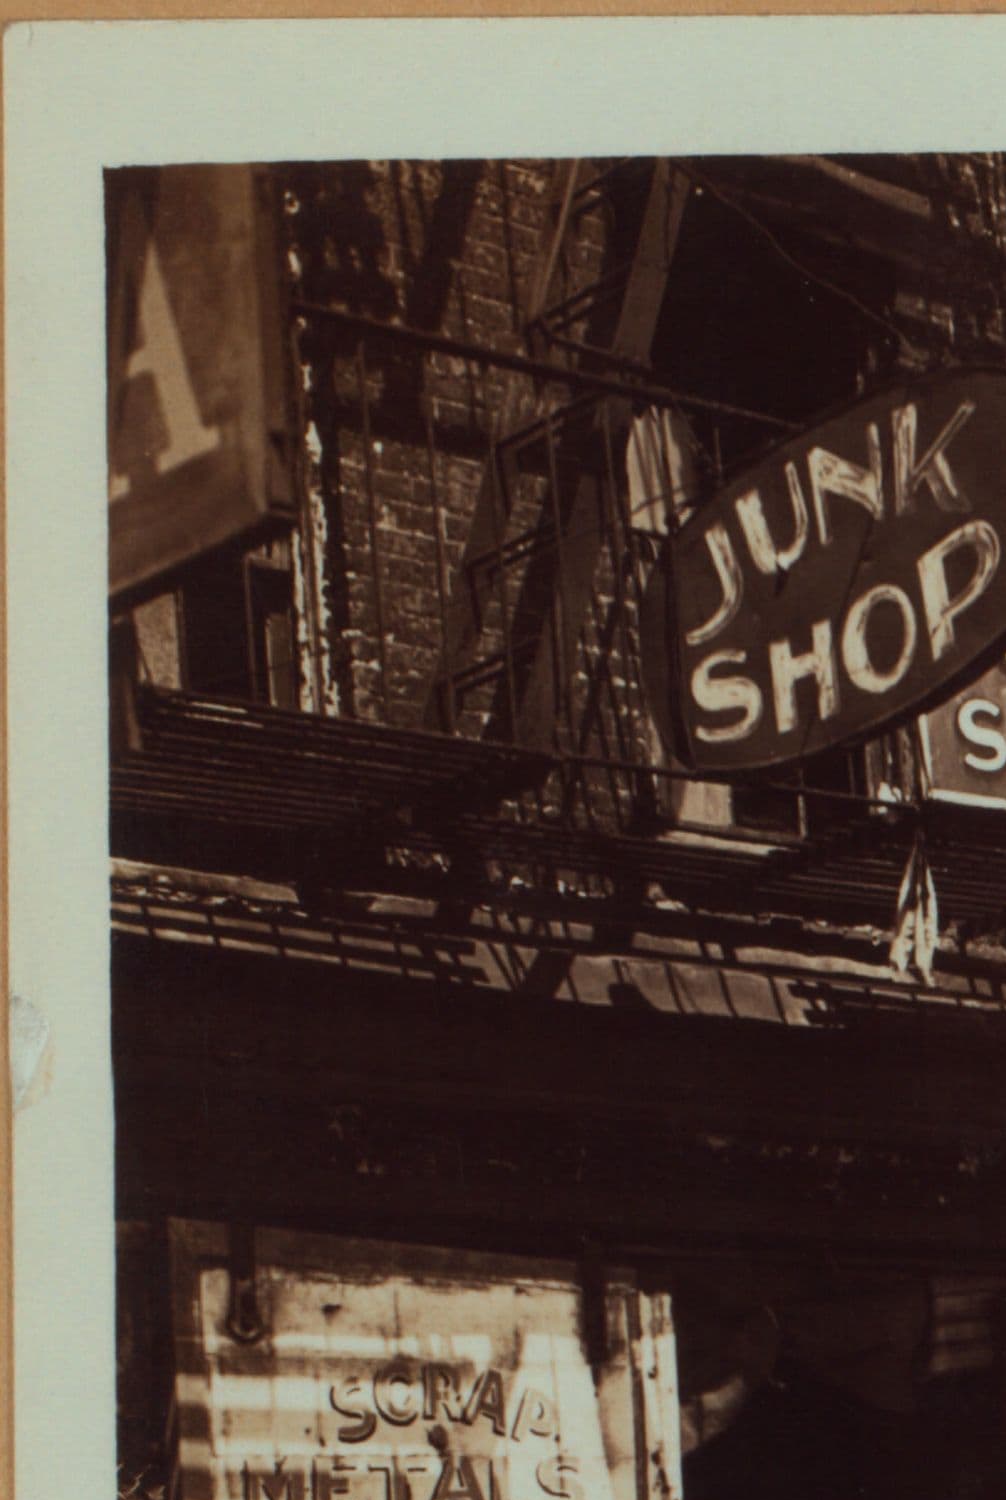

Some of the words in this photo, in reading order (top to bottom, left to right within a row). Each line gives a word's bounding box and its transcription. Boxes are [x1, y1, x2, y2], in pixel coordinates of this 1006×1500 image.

[686, 400, 974, 645] JUNK
[690, 520, 1001, 743] SHOP
[328, 1361, 560, 1445] SCRAP
